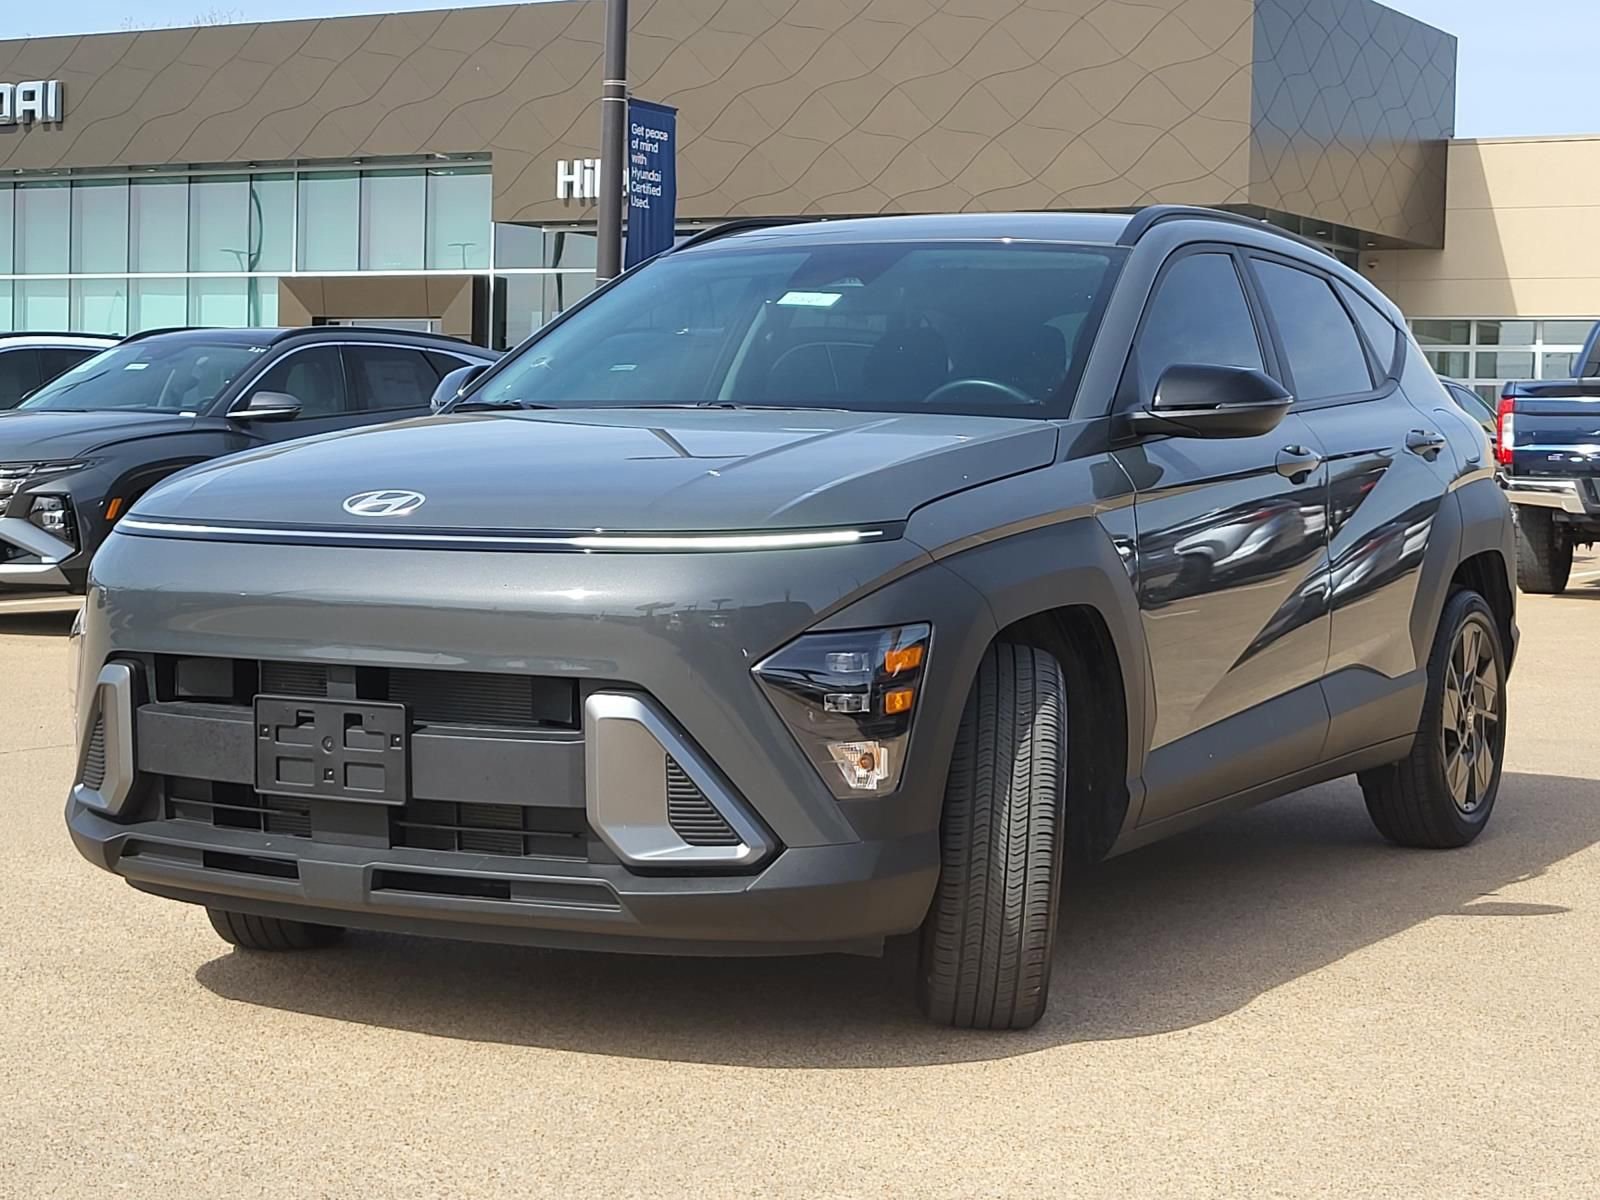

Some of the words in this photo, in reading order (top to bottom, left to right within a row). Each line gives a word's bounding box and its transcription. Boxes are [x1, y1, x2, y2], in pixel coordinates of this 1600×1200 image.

[631, 123, 645, 136] Get
[645, 128, 669, 141] peace
[631, 138, 639, 150] of
[640, 140, 659, 153] mind
[631, 152, 647, 165] with
[631, 166, 662, 182] Hyundai
[631, 181, 662, 196] Certified
[631, 195, 650, 209] Used.
